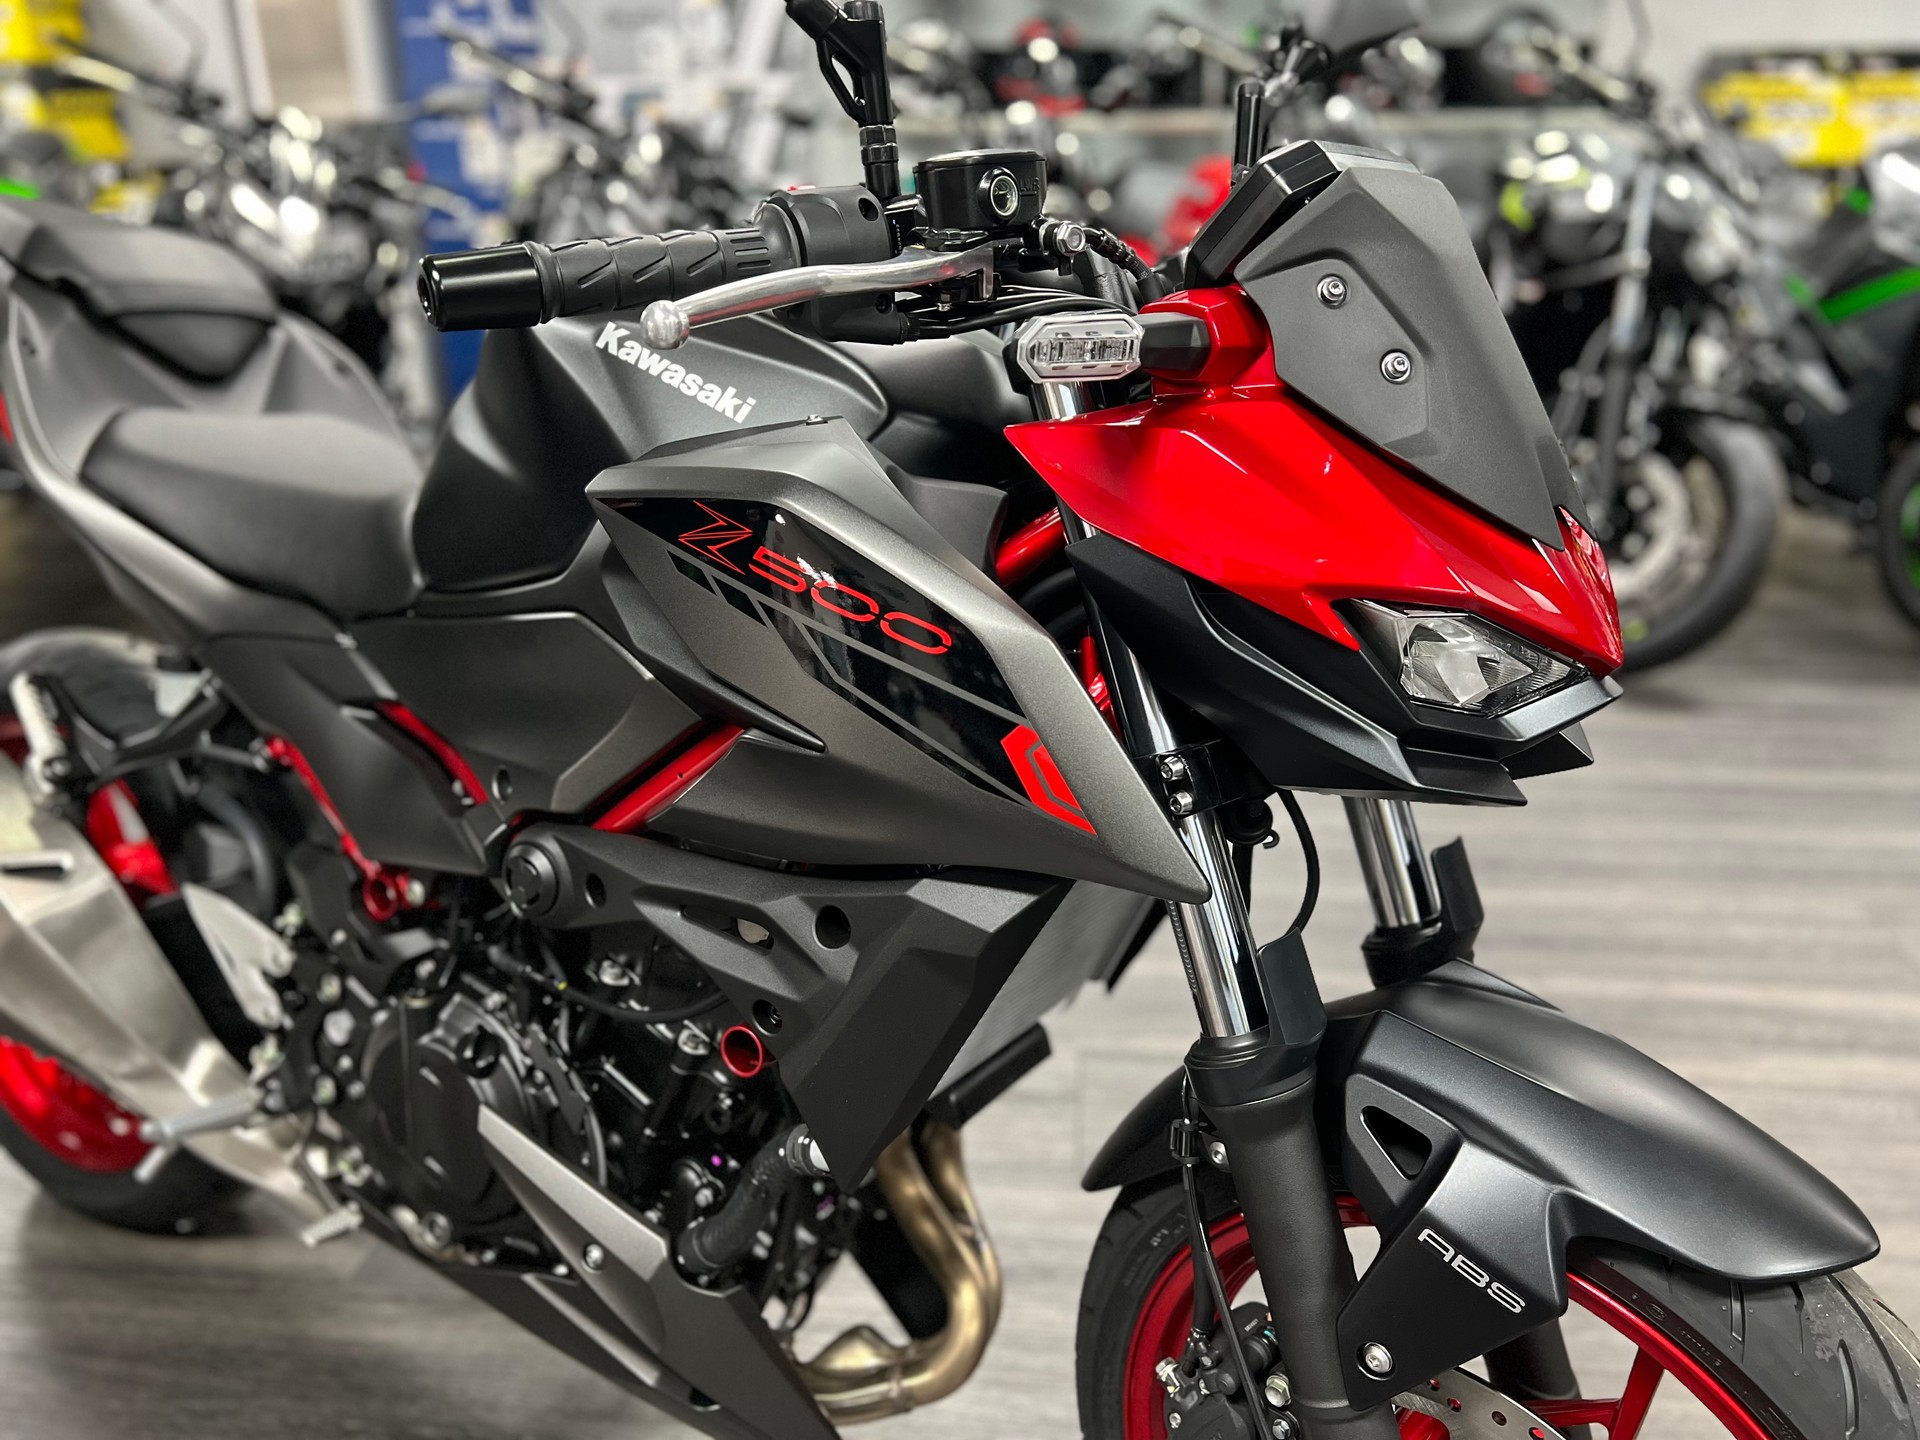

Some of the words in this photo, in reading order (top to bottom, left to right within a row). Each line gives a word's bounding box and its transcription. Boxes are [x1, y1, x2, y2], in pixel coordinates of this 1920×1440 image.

[595, 321, 757, 424] Kawasaki
[678, 500, 952, 655] Z500
[1417, 1228, 1526, 1314] ABS
